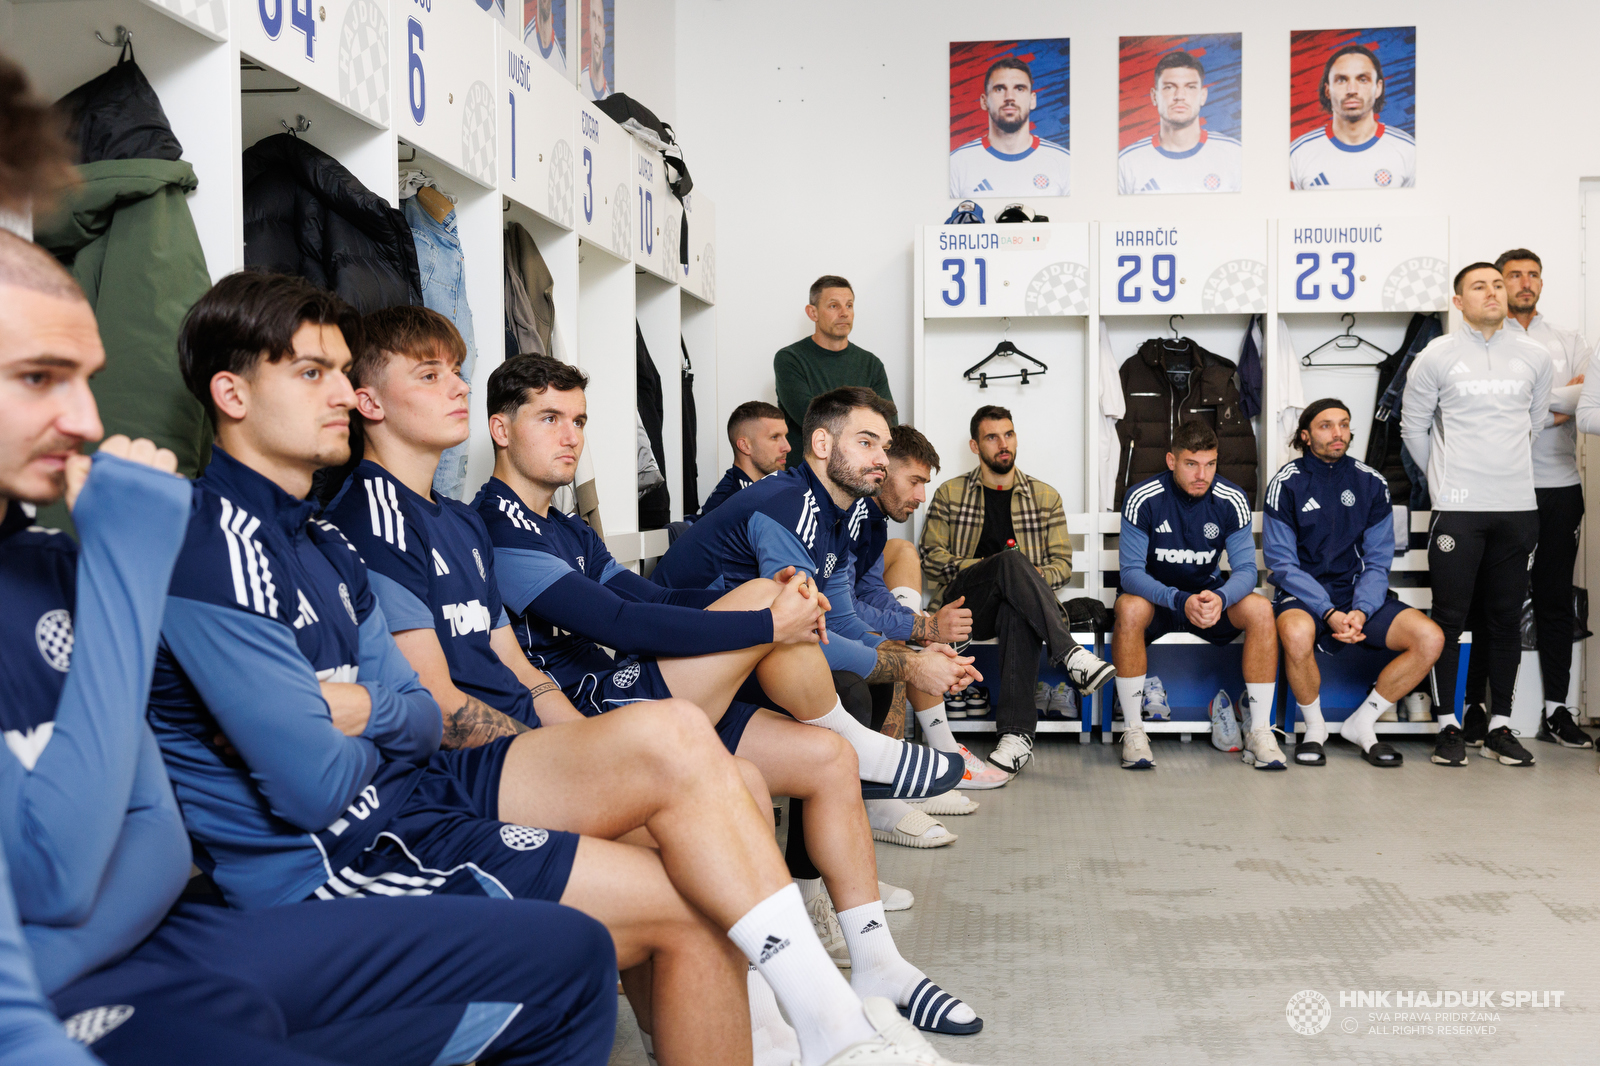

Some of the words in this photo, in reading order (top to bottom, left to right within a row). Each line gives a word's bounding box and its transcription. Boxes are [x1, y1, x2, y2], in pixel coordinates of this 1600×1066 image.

[340, 1, 388, 75] HAJDUK
[408, 15, 426, 126] 6
[508, 49, 531, 92] IVUŠIĆ
[508, 89, 516, 182] 1
[583, 146, 593, 225] 3
[638, 184, 653, 257] 10
[1116, 227, 1178, 247] KARAČIĆ
[1294, 224, 1382, 244] KROVINOVIĆ
[940, 232, 998, 250] ŠARLIJA
[1001, 236, 1023, 245] DABO
[941, 257, 988, 307] 31
[1026, 263, 1088, 303] HAJDUK
[1116, 253, 1177, 303] 29
[1203, 260, 1266, 300] HAJDUK
[1295, 252, 1356, 301] 23
[1383, 258, 1447, 298] HAJDUK
[1455, 379, 1526, 396] TOMMY
[1450, 488, 1469, 503] AP
[1155, 547, 1217, 565] TOMMY
[760, 939, 790, 964] adidas
